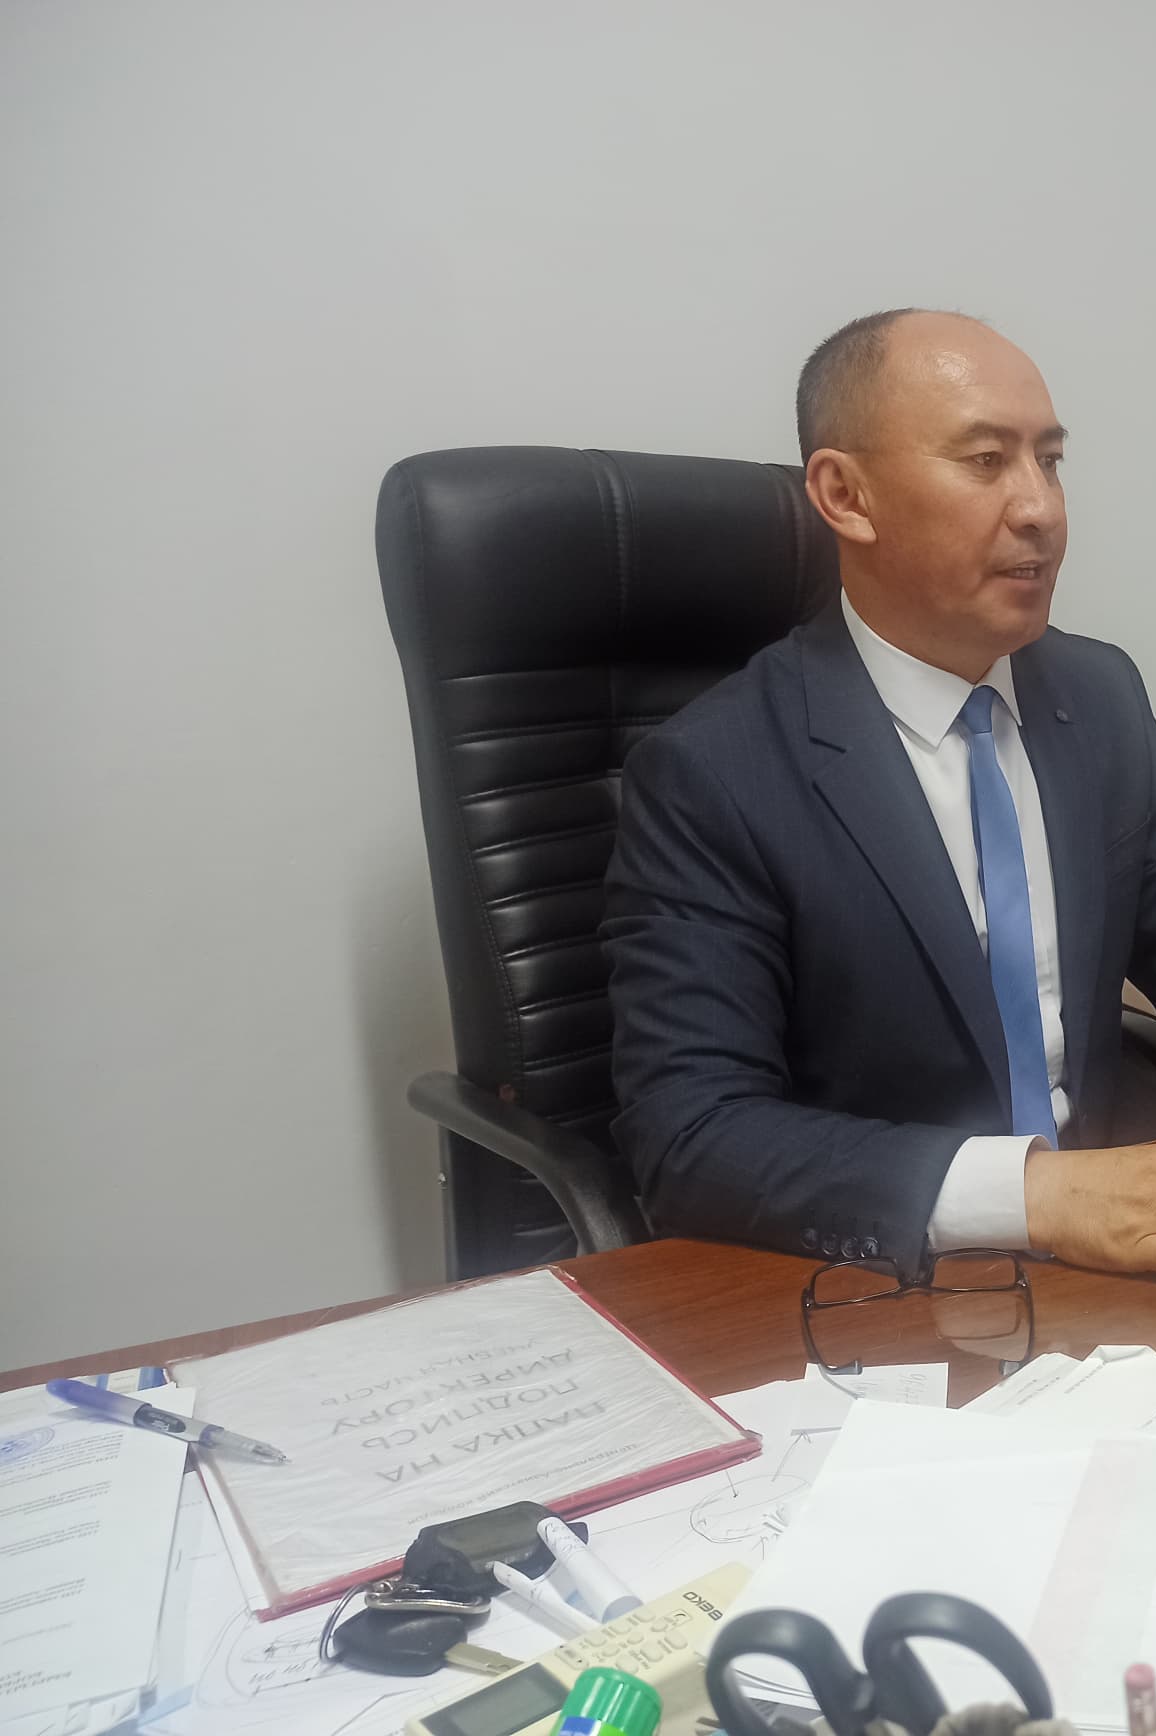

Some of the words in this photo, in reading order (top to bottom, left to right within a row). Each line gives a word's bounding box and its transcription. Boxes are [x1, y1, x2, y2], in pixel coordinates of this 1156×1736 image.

[330, 1348, 573, 1436] ДИРЕКТОРУ
[361, 1378, 579, 1450] ПОДПИСЬ
[452, 1400, 607, 1452] ПАПКА
[374, 1453, 444, 1483] НА
[682, 1591, 723, 1621] BEKO
